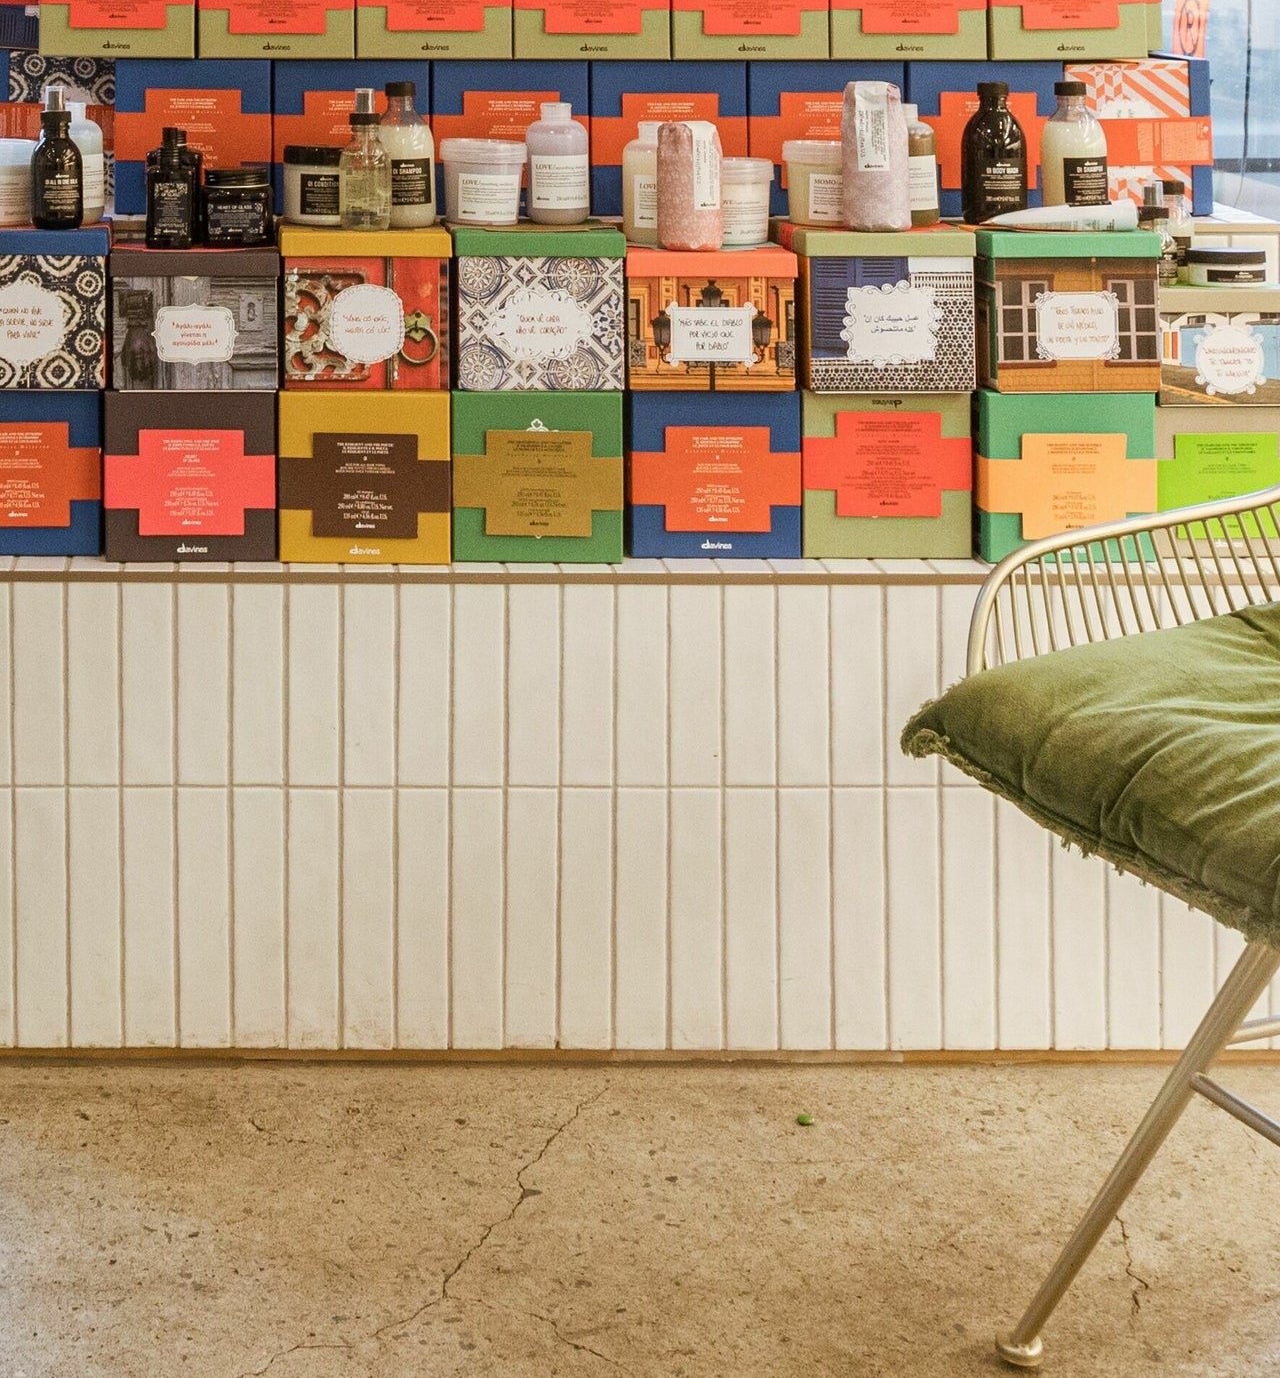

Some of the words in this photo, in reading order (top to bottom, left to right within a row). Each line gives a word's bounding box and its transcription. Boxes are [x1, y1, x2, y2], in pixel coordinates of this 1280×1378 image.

[102, 41, 130, 49] davines
[262, 42, 290, 50] davines
[421, 42, 449, 50] davines
[580, 43, 607, 51] davines
[738, 43, 766, 51] davines
[896, 43, 923, 51] davines
[1057, 43, 1084, 51] davines
[177, 544, 207, 553] davines
[701, 540, 732, 549] davines
[349, 545, 380, 554] davines
